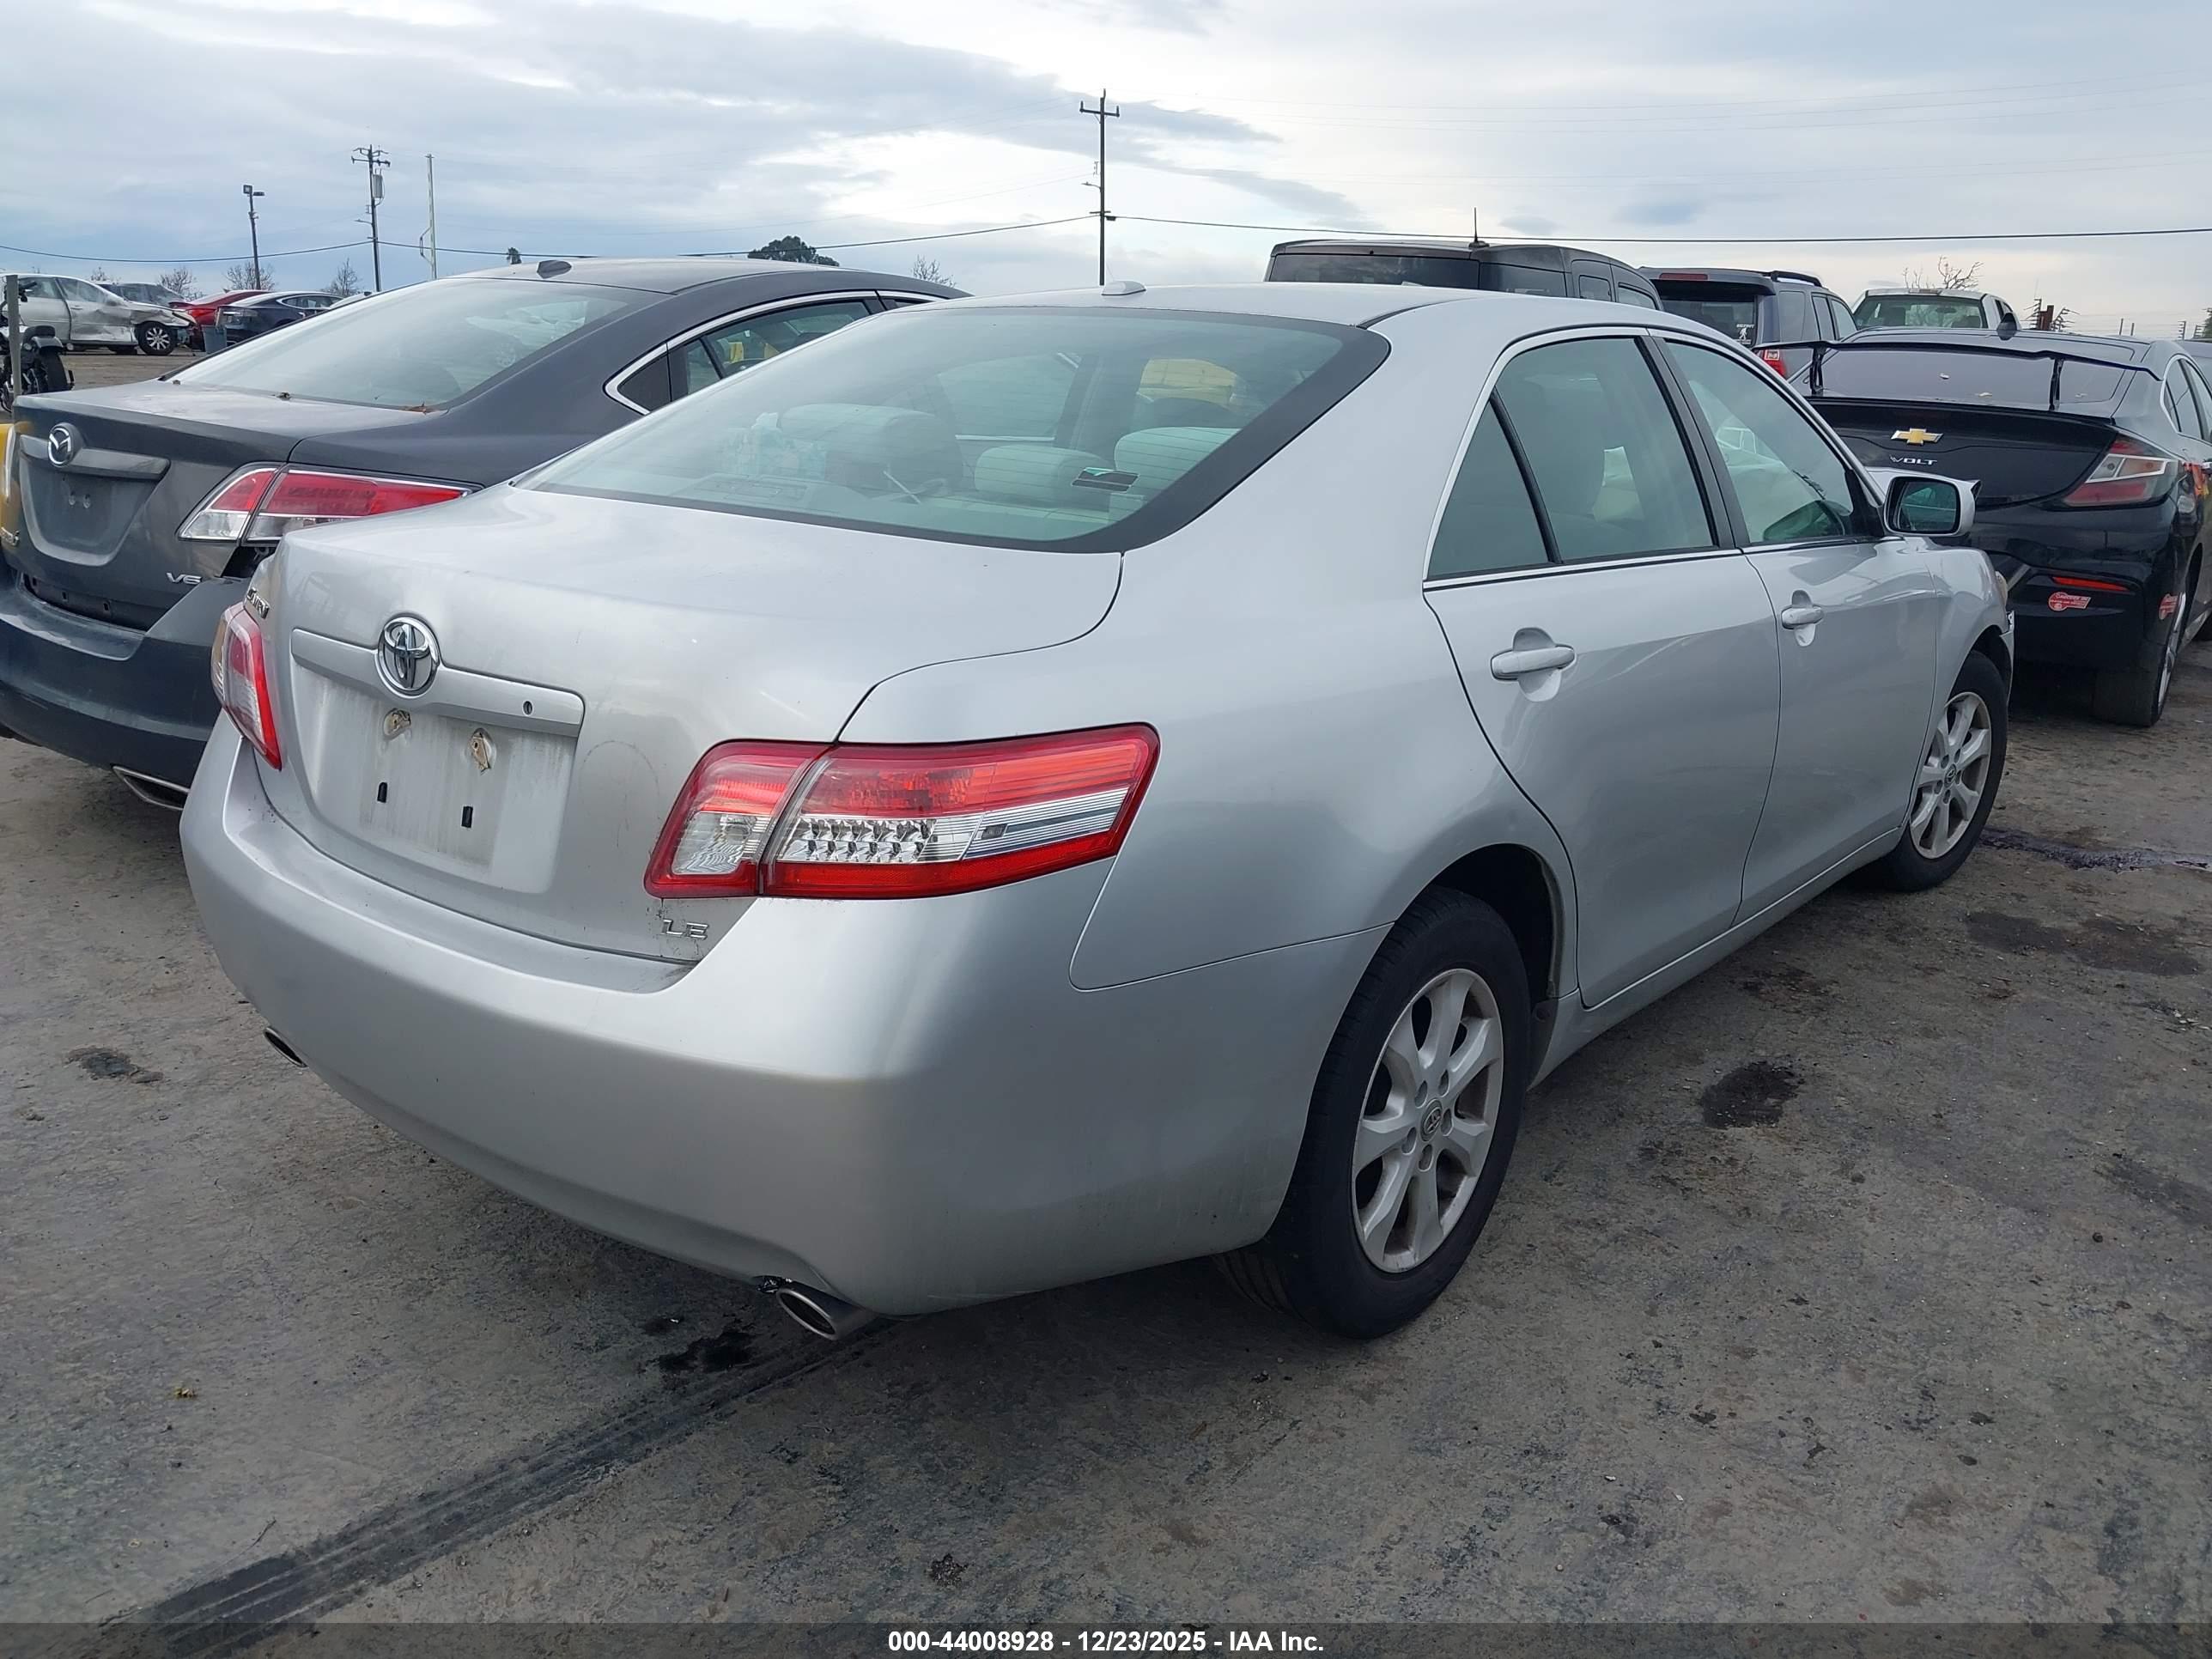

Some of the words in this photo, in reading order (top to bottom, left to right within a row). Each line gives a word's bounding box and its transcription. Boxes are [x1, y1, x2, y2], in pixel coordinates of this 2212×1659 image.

[1889, 454, 1938, 465] VOLT
[166, 572, 202, 585] V6
[660, 918, 709, 940] LE
